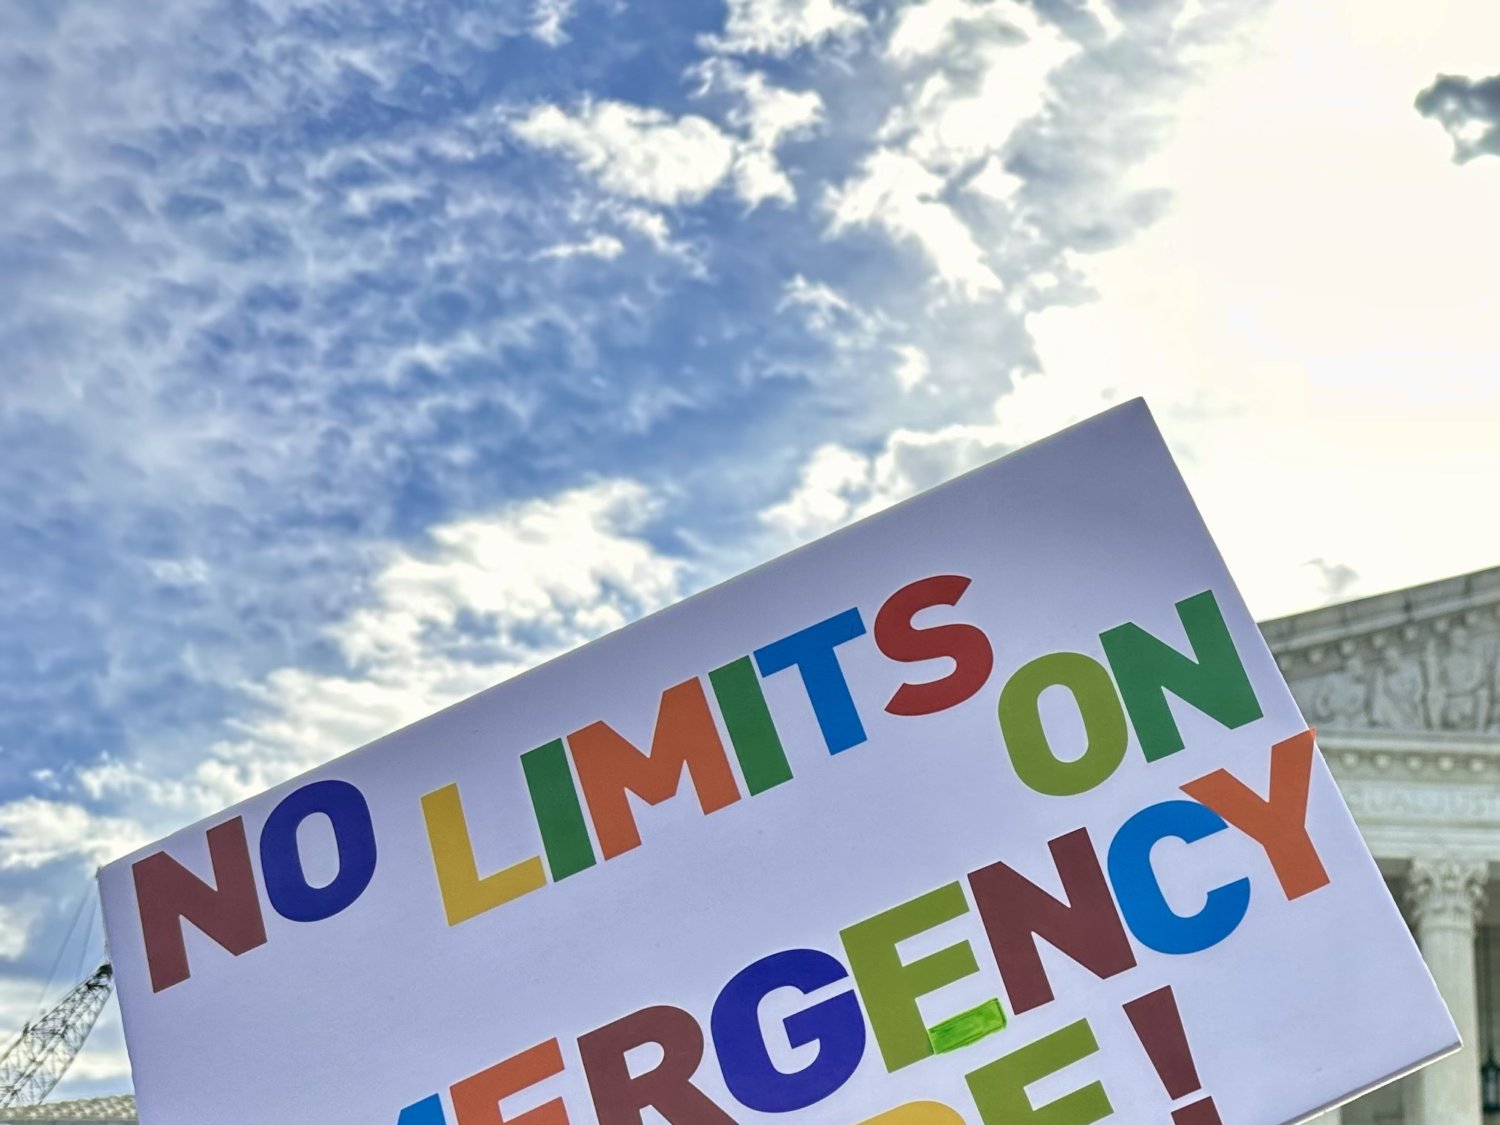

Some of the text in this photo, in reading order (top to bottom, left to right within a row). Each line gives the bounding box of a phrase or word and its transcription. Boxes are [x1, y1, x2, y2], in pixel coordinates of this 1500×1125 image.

[132, 574, 1264, 993] NO LIMITS ON
